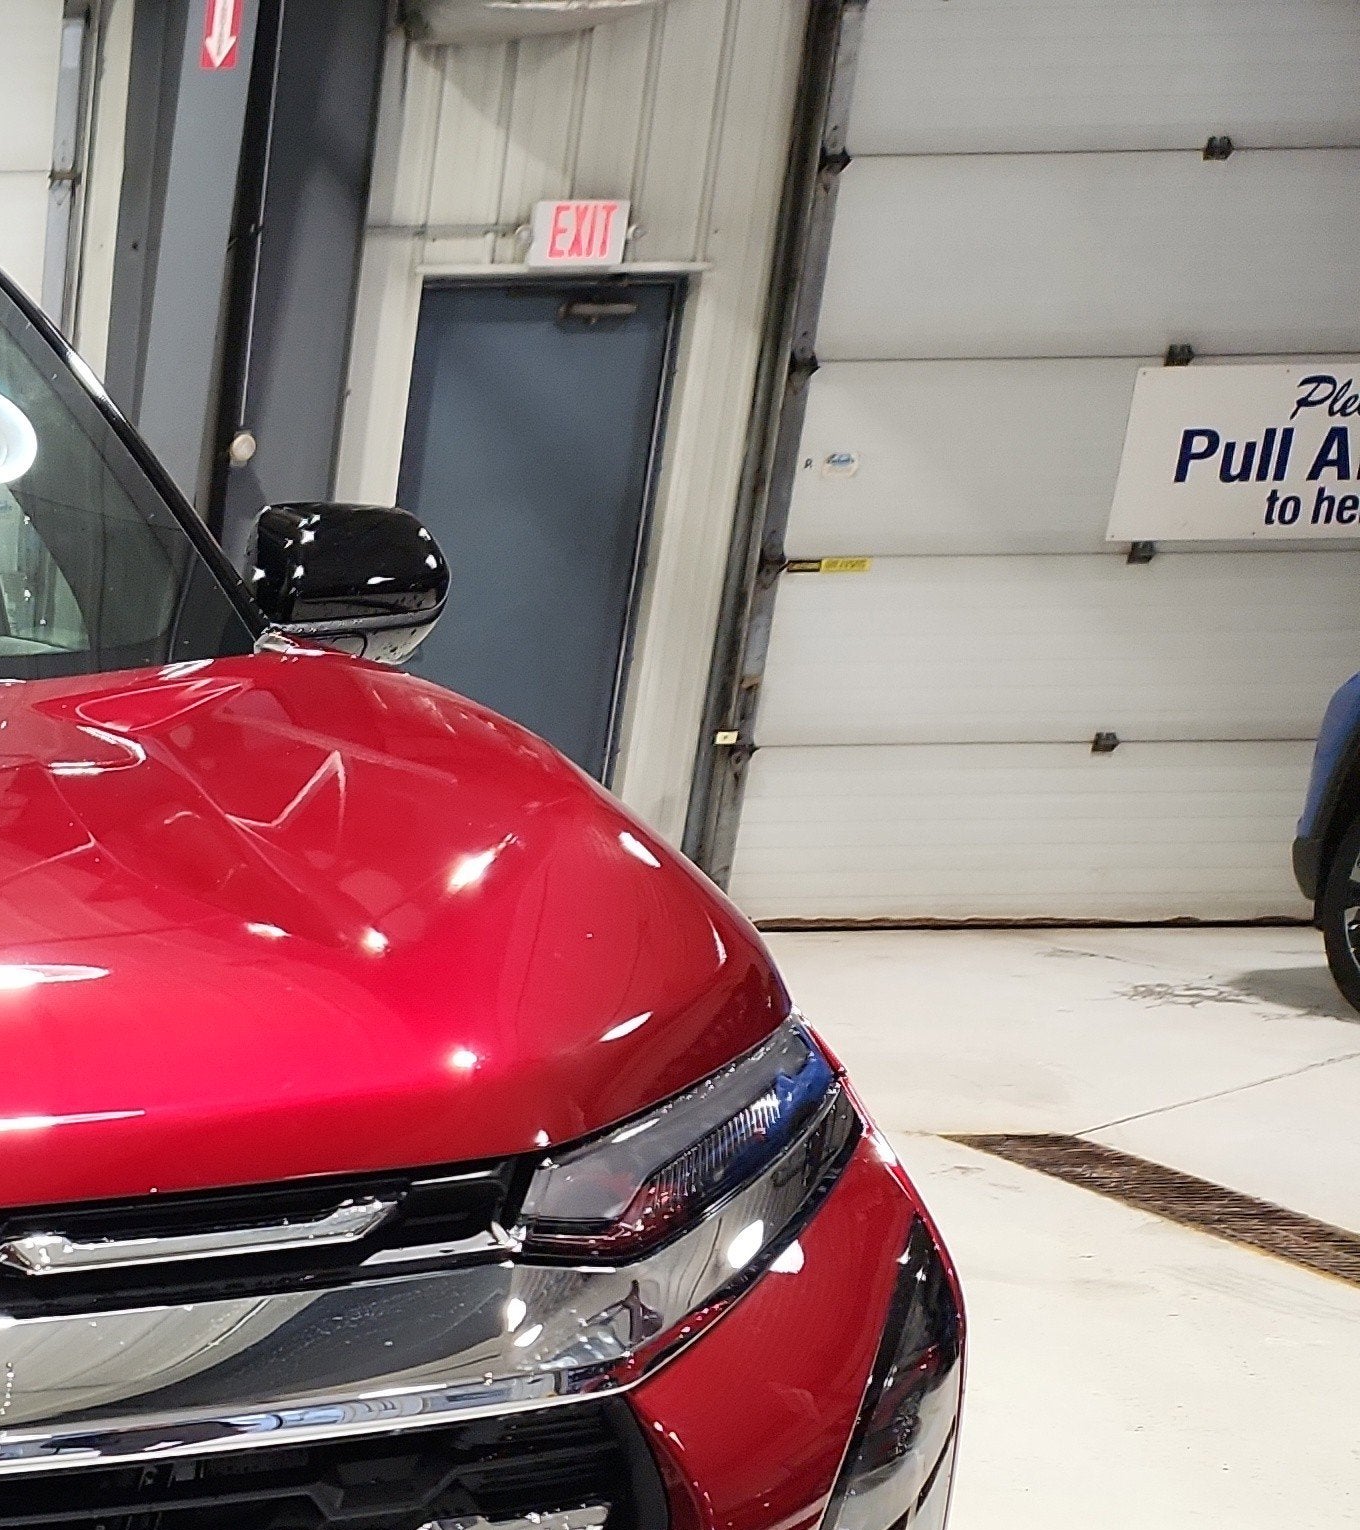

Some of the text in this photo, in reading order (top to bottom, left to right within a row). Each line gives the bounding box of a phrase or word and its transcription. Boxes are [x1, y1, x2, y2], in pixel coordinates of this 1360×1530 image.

[547, 202, 619, 259] EXIT
[1290, 374, 1360, 420] Ple
[1173, 426, 1360, 484] Pull A
[1264, 486, 1360, 525] to he
